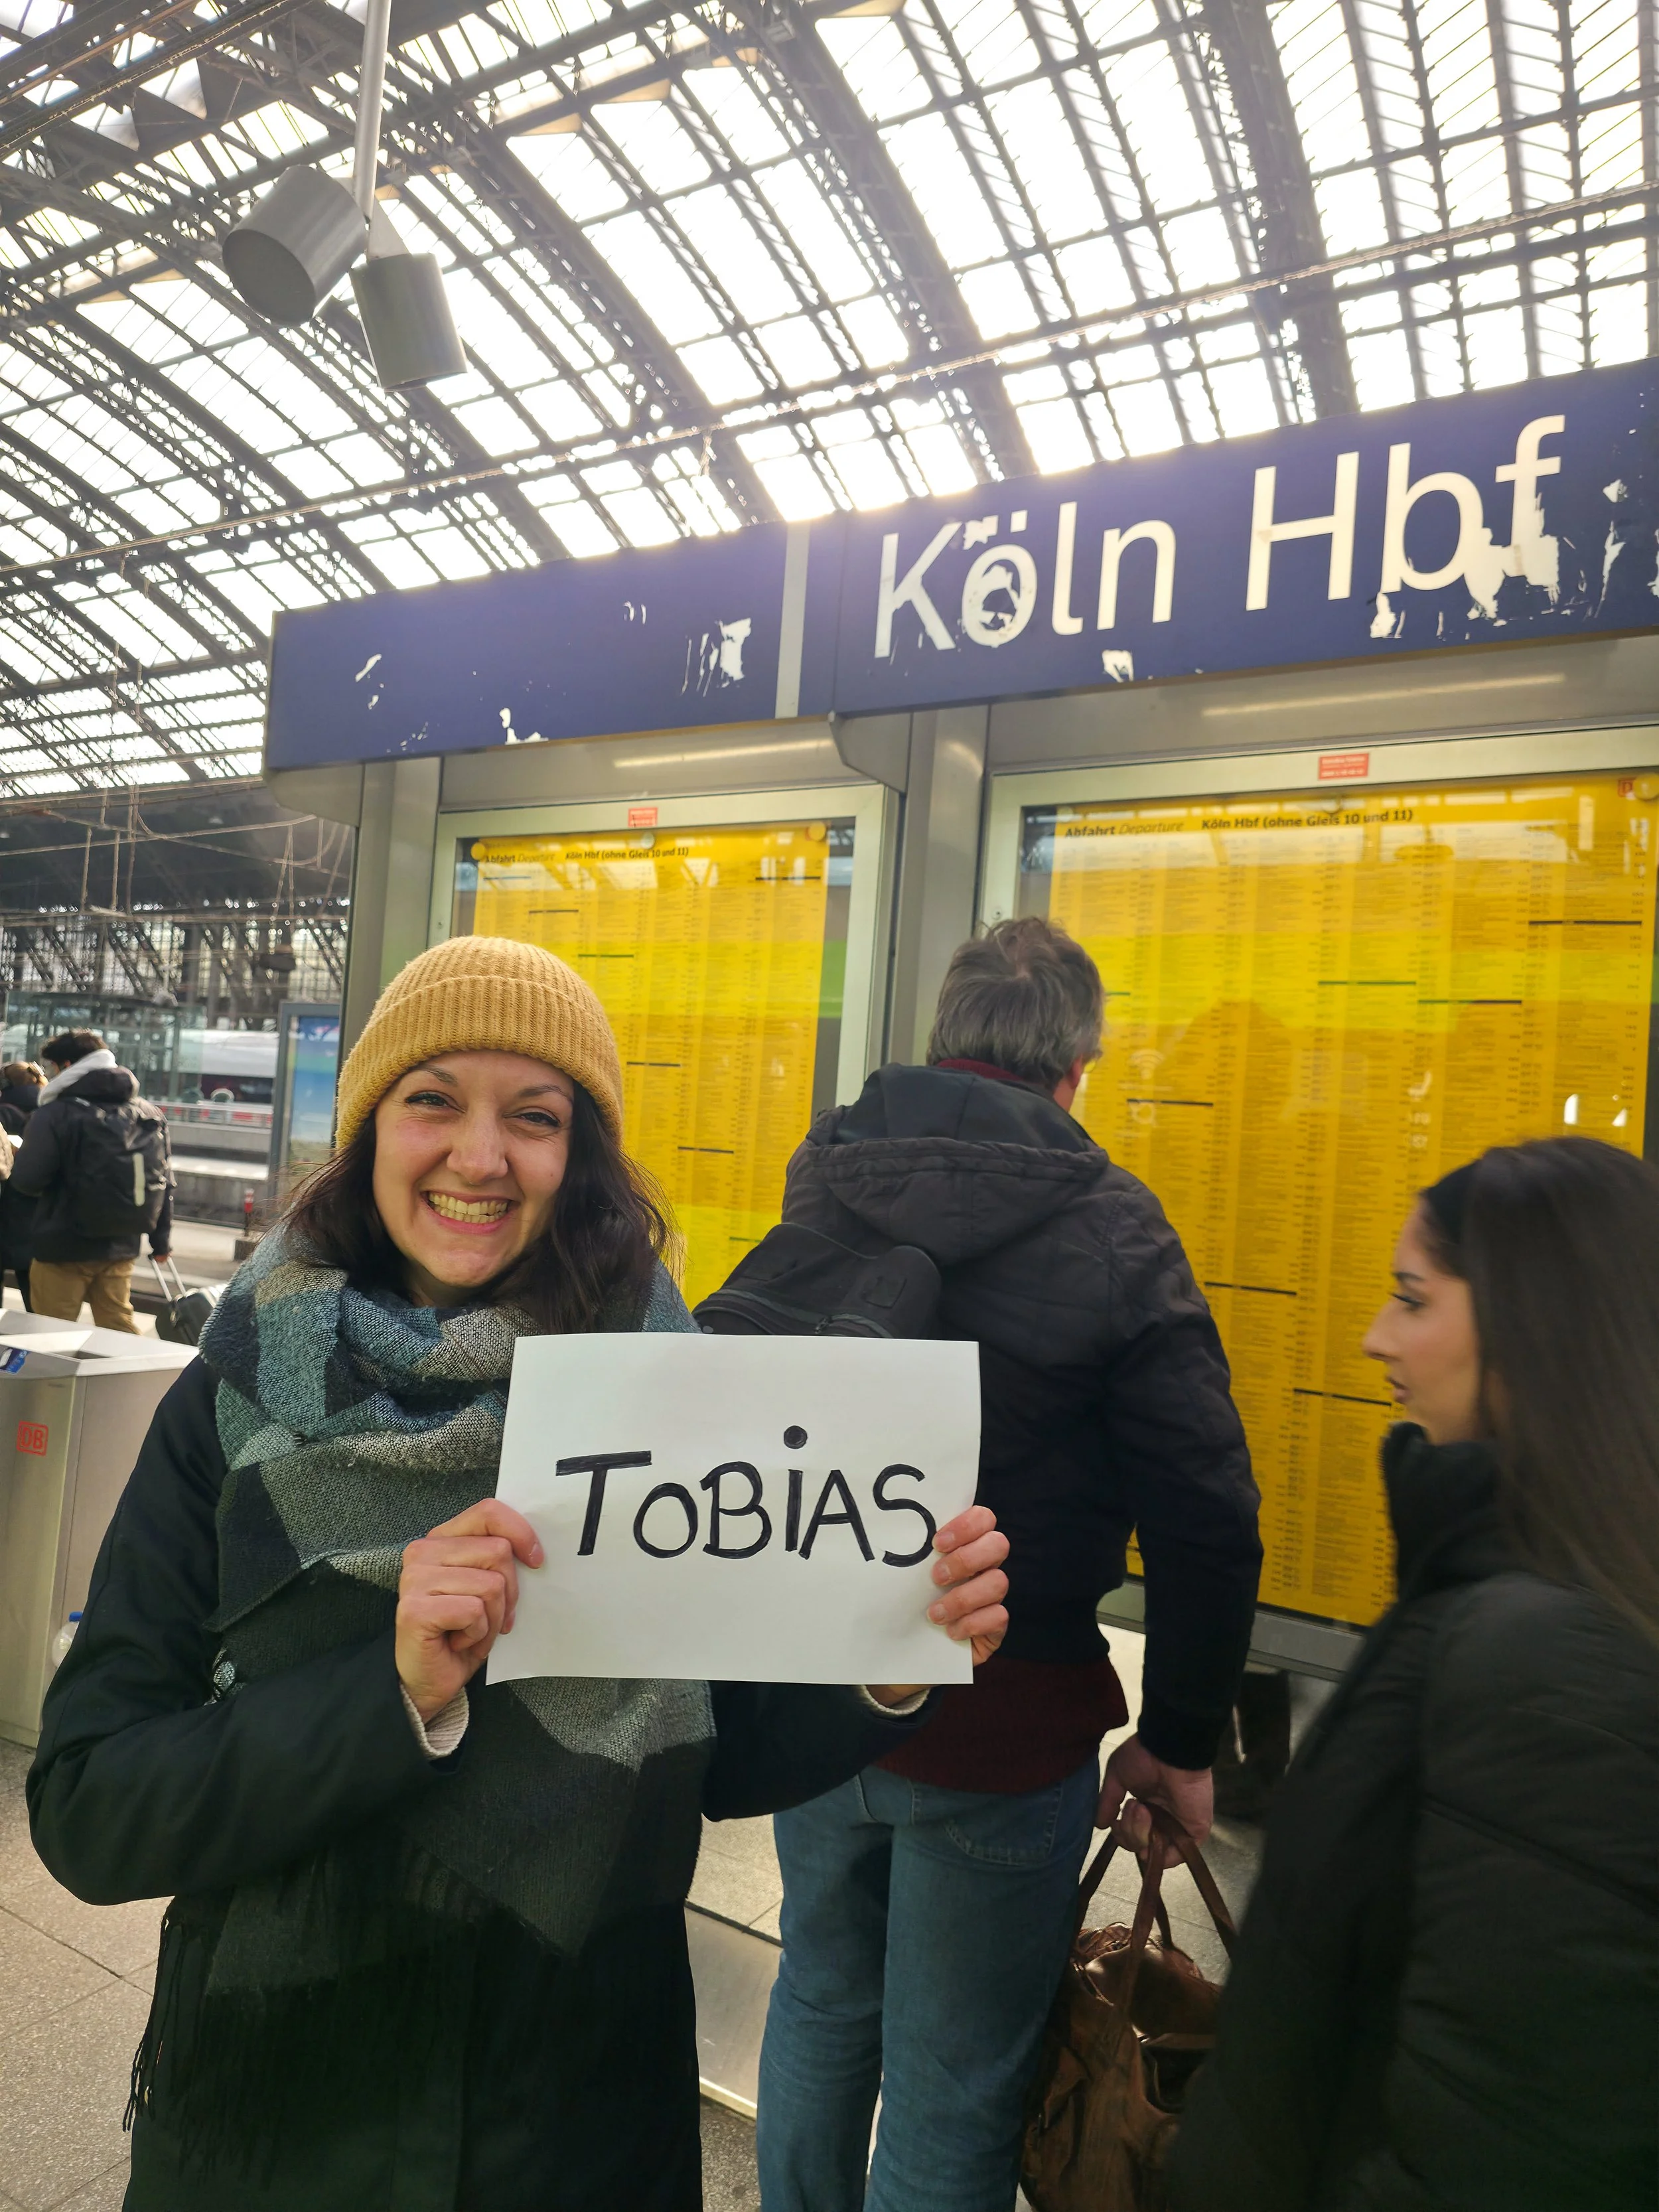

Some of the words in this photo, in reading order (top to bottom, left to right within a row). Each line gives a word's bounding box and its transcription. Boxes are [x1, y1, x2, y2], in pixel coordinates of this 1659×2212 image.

[874, 501, 1176, 658] Köln
[1246, 414, 1565, 614] Hbf
[1202, 818, 1230, 830] Köln
[1235, 817, 1259, 828] Hbf
[1263, 816, 1303, 829] (ohne
[1306, 814, 1340, 827] Gleis
[1344, 814, 1360, 825] 10
[1364, 811, 1389, 823] und
[1393, 809, 1413, 822] 11)
[1064, 824, 1116, 838] Abfahrt
[1119, 822, 1185, 836] Departure
[584, 849, 599, 859] Hbf
[602, 849, 626, 861] (ohne
[652, 849, 661, 858] 10
[663, 848, 675, 857] und
